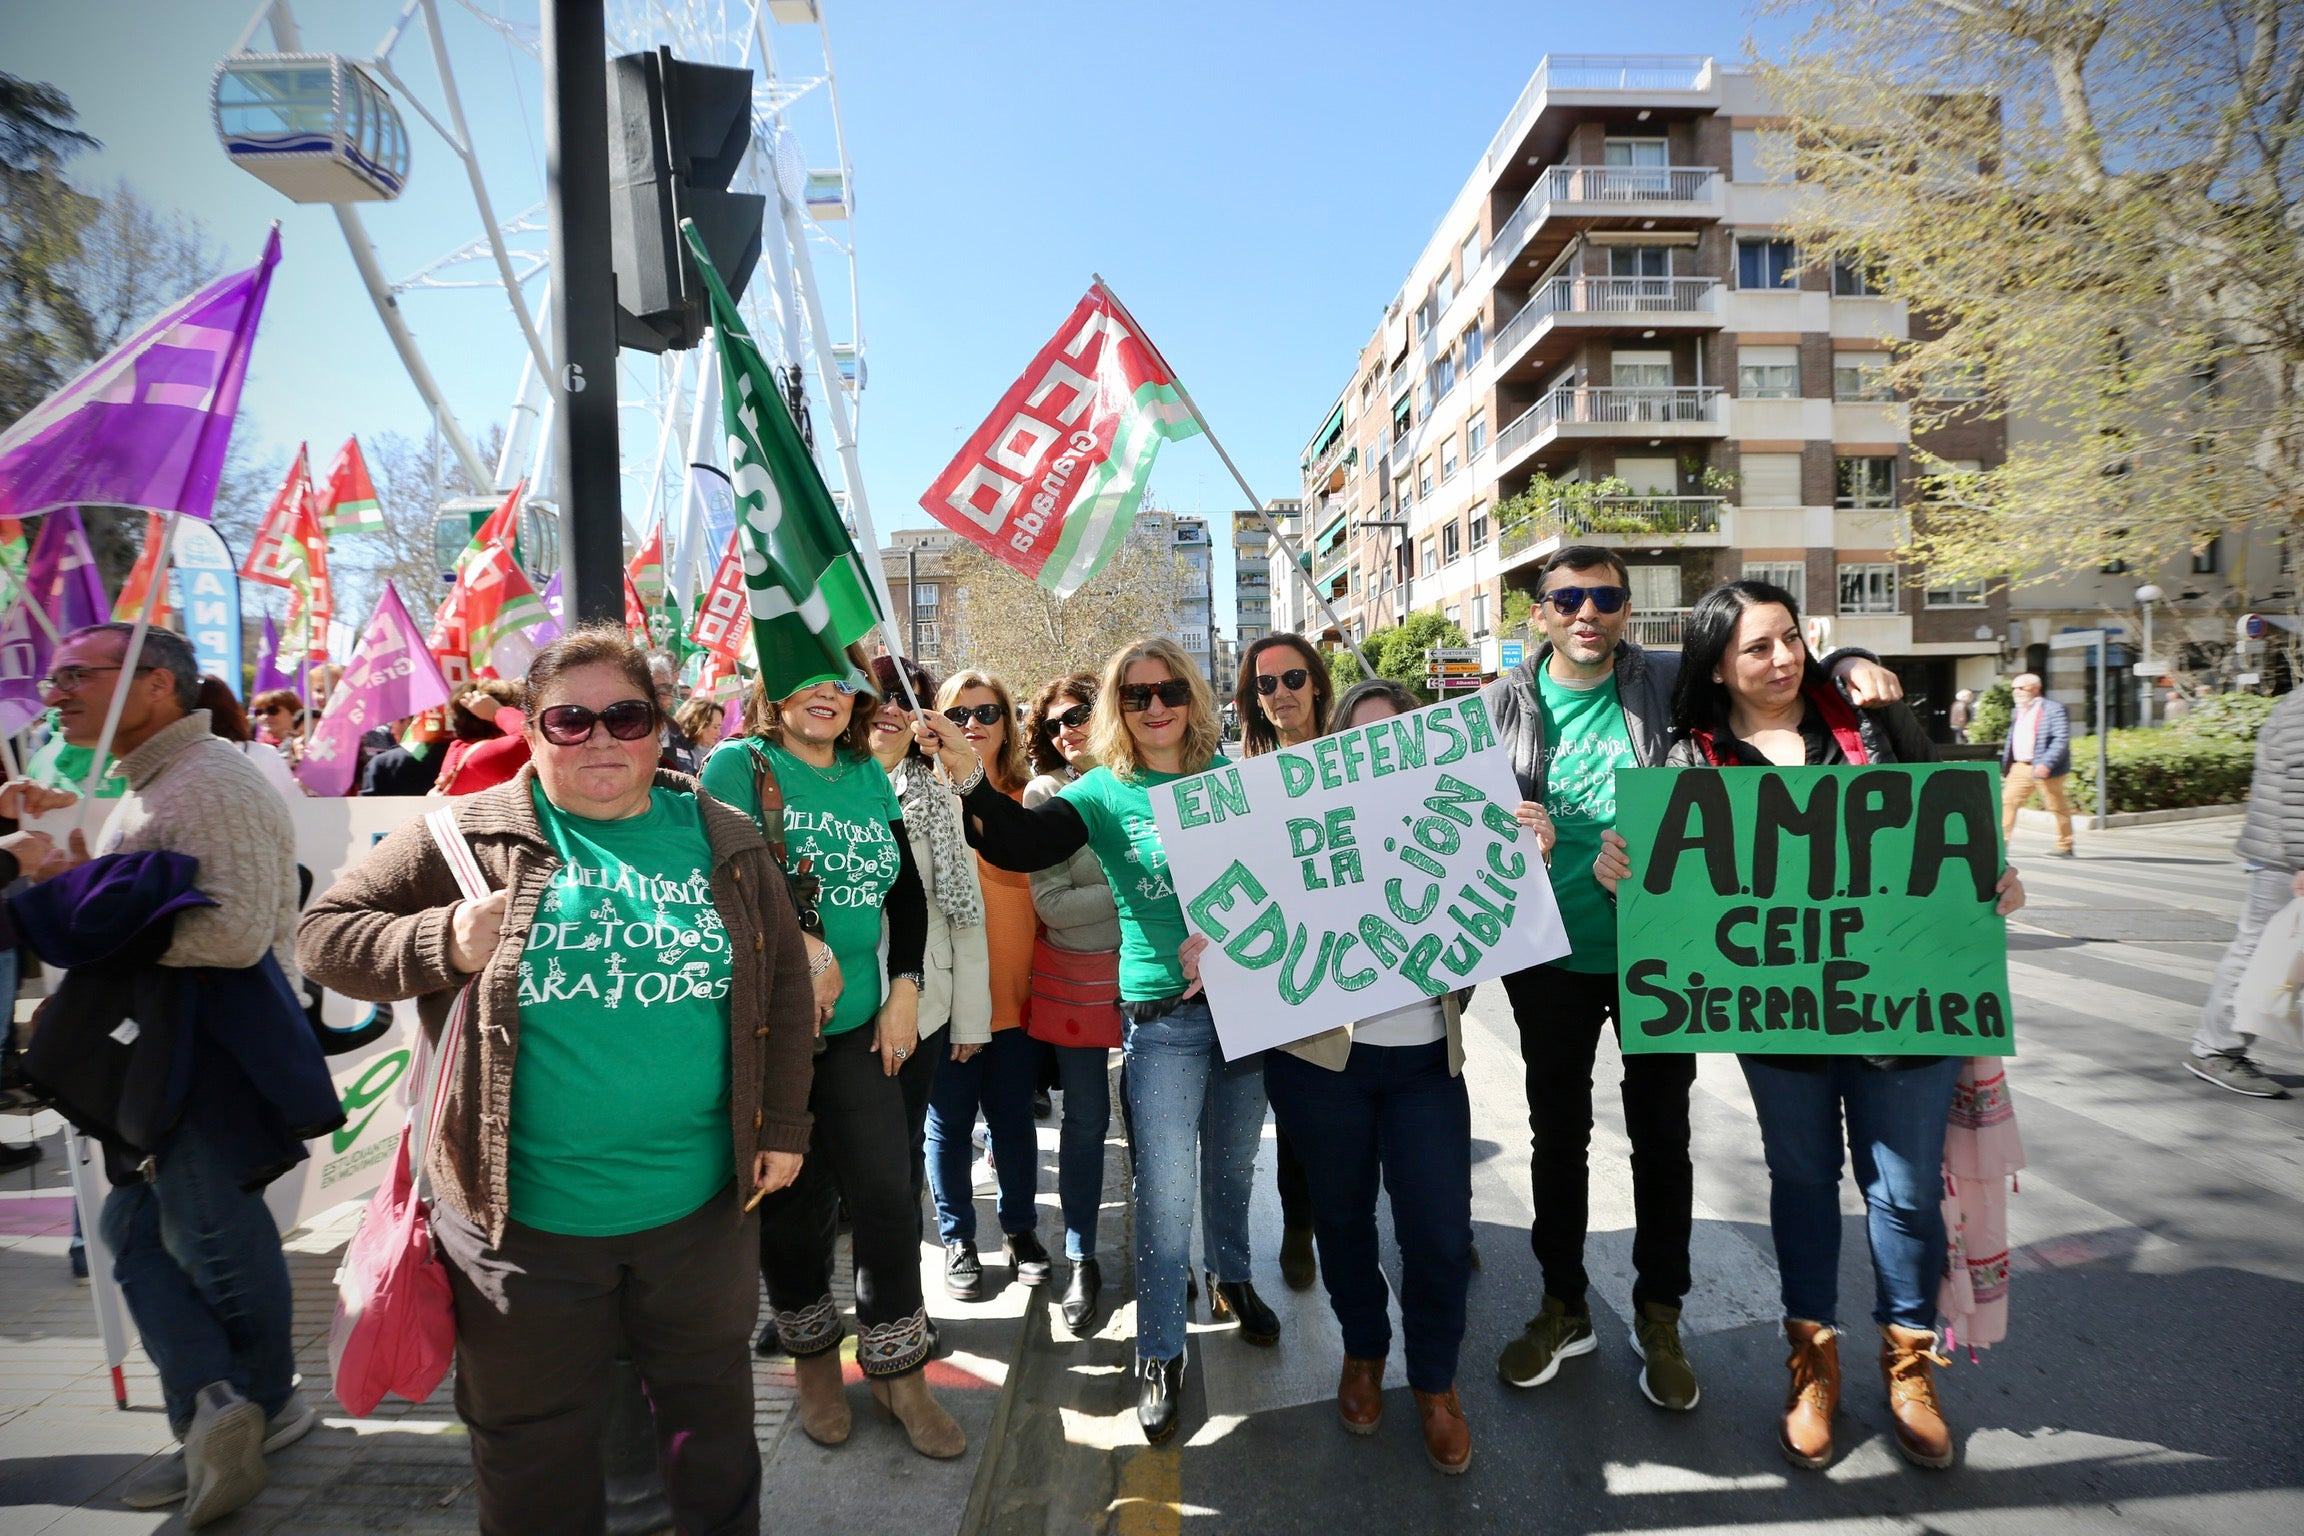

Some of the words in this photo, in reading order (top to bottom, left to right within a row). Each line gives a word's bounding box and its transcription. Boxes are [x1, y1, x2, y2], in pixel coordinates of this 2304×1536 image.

[562, 363, 587, 392] 6
[1172, 768, 1251, 830] EN
[1276, 696, 1497, 799] DEFENSA
[1548, 776, 1572, 794] DE
[1286, 806, 1357, 858] DE
[1302, 849, 1364, 891] LA
[636, 872, 716, 906] PÚBLIC
[525, 921, 586, 951] DE
[517, 972, 600, 1004] ARA
